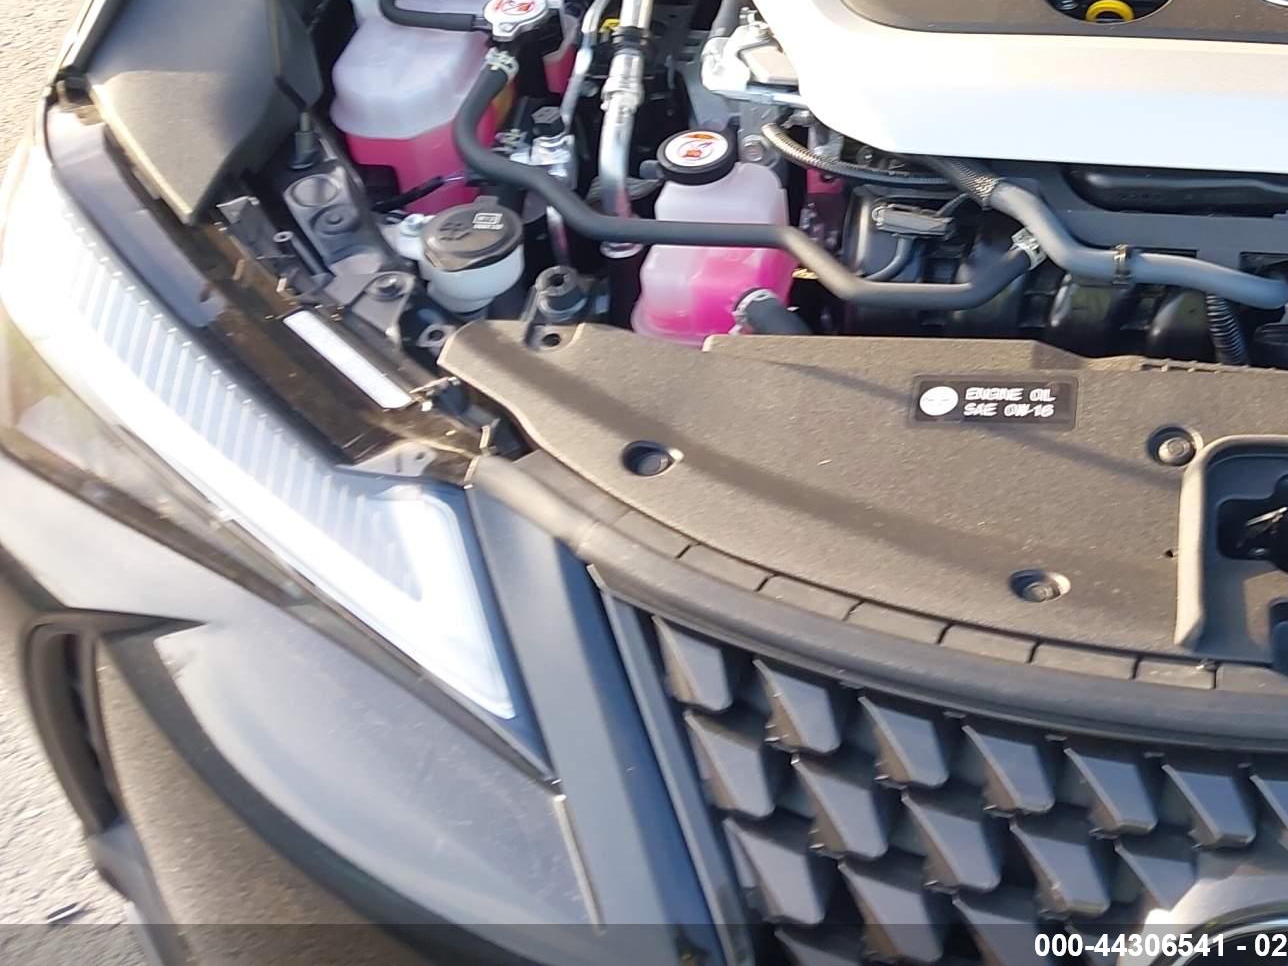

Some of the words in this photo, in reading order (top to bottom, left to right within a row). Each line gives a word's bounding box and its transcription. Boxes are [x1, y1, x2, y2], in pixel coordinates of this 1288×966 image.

[965, 387, 1024, 401] ENGINE
[1029, 388, 1056, 402] OIL
[963, 402, 998, 416] SAE
